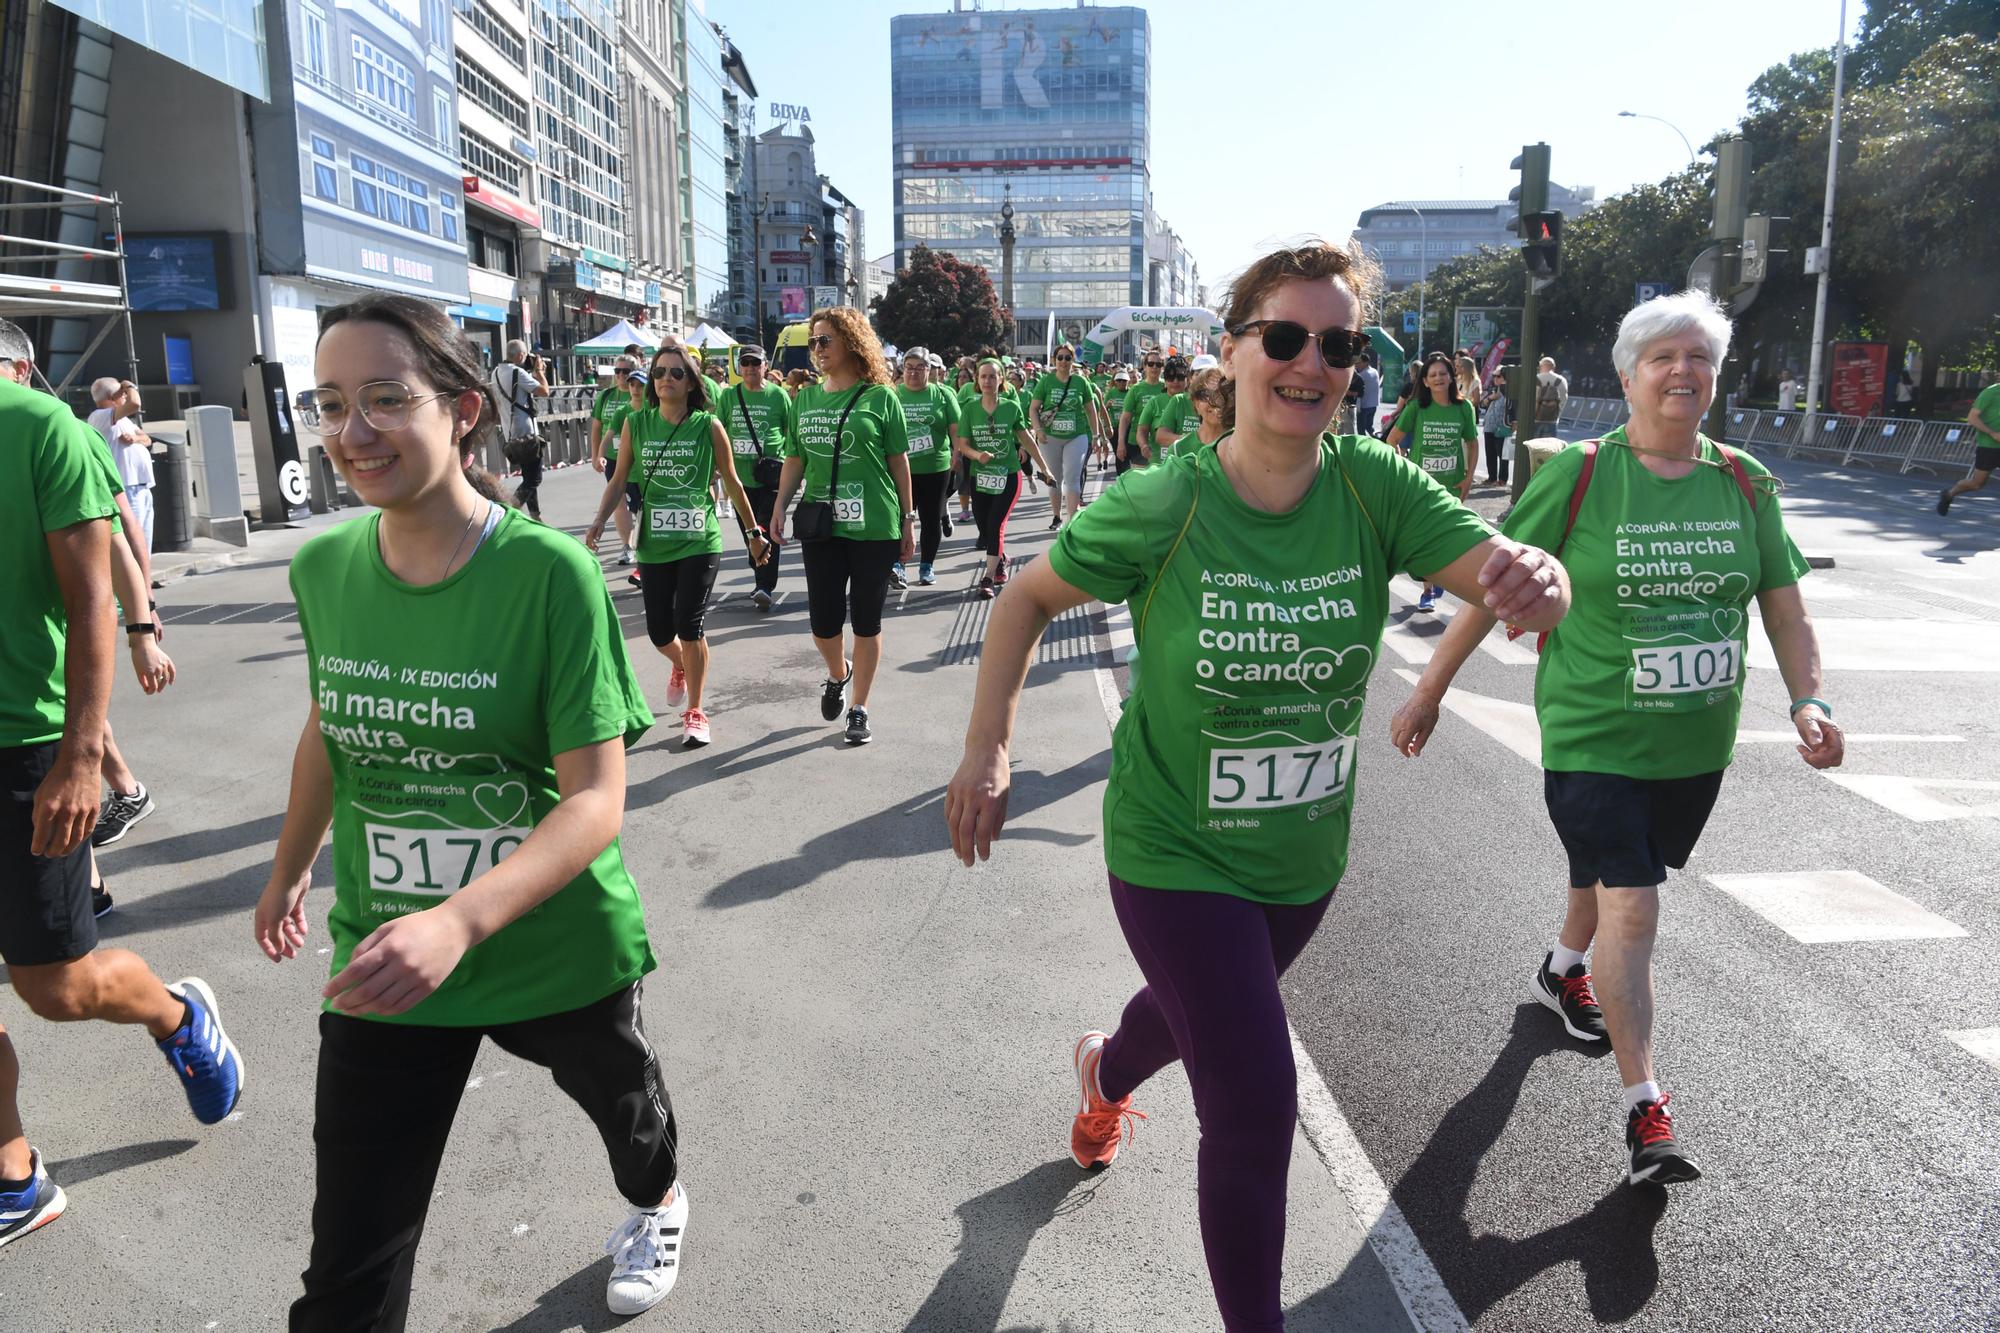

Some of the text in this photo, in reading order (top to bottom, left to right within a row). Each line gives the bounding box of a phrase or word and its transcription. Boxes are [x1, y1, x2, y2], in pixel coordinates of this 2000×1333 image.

[771, 102, 811, 121] BBVA
[1463, 313, 1481, 321] YES
[641, 448, 653, 457] En
[1424, 457, 1455, 470] 5401
[978, 475, 1006, 488] 5730
[652, 511, 704, 529] 5436
[1616, 518, 1740, 535] A CORUÑA IX EDICIÓN
[1616, 536, 1735, 556] En marcha
[1616, 558, 1693, 577] contra
[1201, 570, 1212, 584] A
[1282, 580, 1298, 594] IX
[1300, 565, 1362, 592] EDICIÓN
[1617, 584, 1632, 597] o
[1201, 592, 1357, 624] En marcha
[1680, 610, 1709, 620] marcha
[1198, 627, 1300, 653] contra
[319, 655, 498, 689] A CORUÑA IX EDICIÓN
[1196, 659, 1215, 679] o
[1636, 646, 1735, 690] 5101
[319, 680, 475, 730] En marcha
[1263, 705, 1277, 715] en
[1279, 702, 1321, 715] marcha
[1643, 700, 1654, 708] de
[1213, 718, 1249, 730] contra
[1262, 717, 1300, 728] cancro
[320, 720, 408, 748] contra
[1213, 745, 1345, 803] 5171
[404, 784, 418, 794] en
[420, 785, 465, 796] marcha
[1222, 818, 1236, 828] de
[384, 903, 397, 912] de
